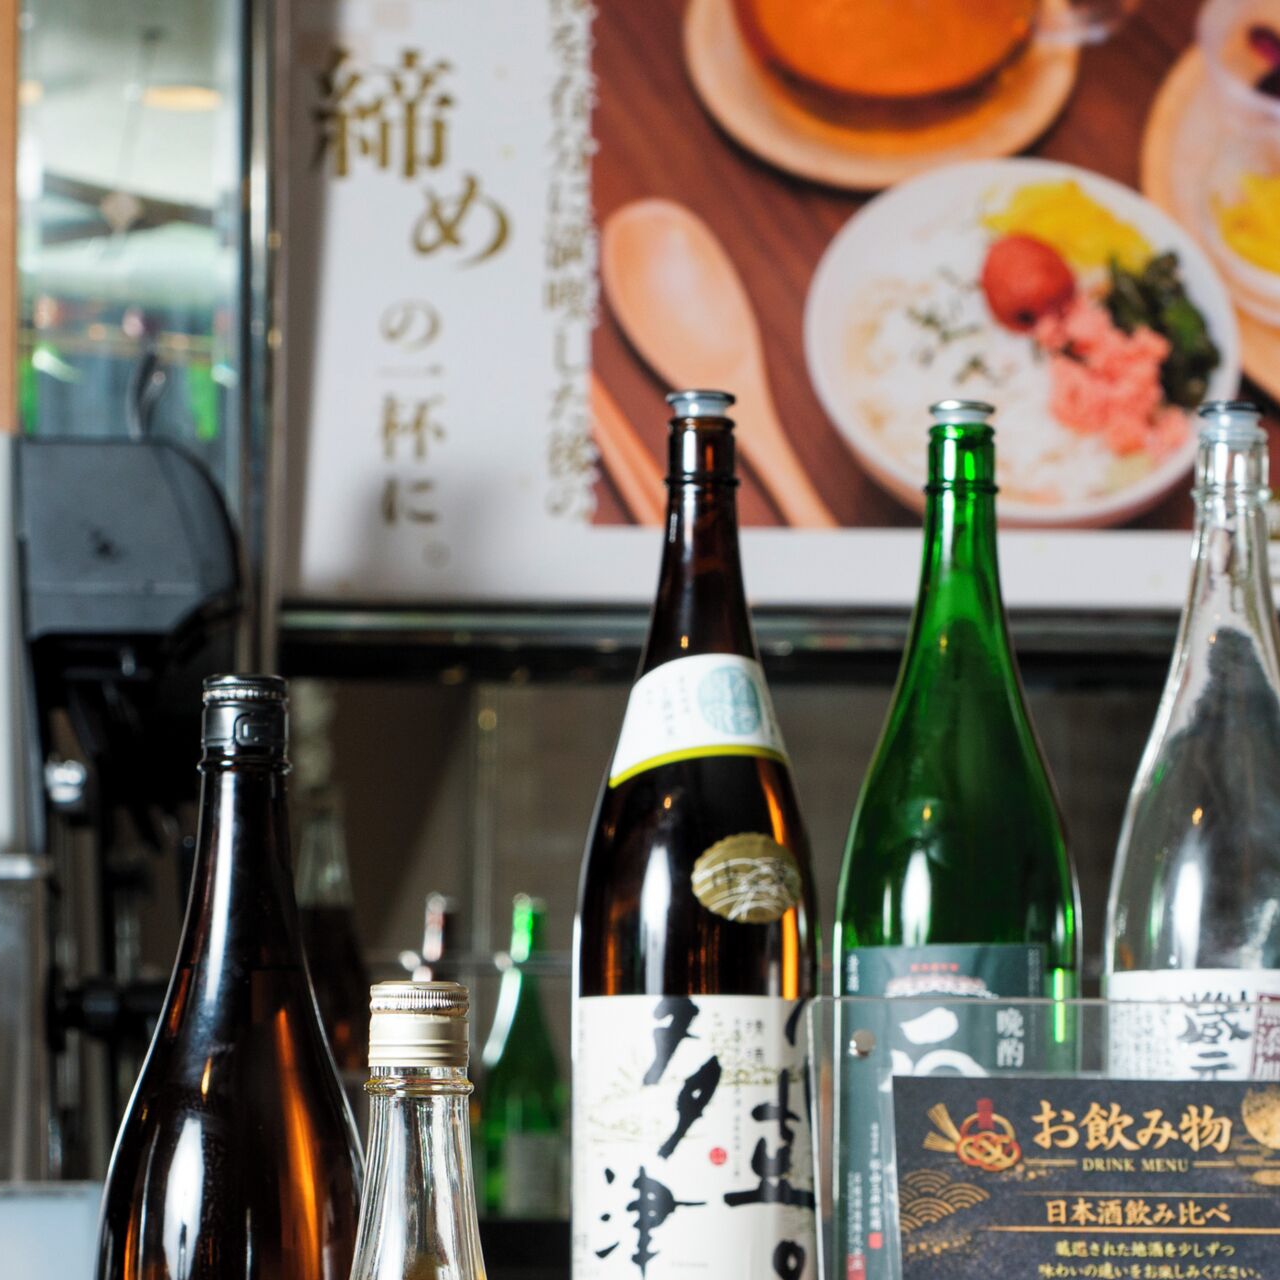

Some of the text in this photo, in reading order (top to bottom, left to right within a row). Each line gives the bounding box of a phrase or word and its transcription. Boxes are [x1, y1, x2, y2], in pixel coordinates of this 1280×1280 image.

[1031, 1100, 1232, 1152] お飲み物
[1082, 1158, 1189, 1173] DRINK MENU
[1046, 1201, 1231, 1226] 日本酒飲み比べ
